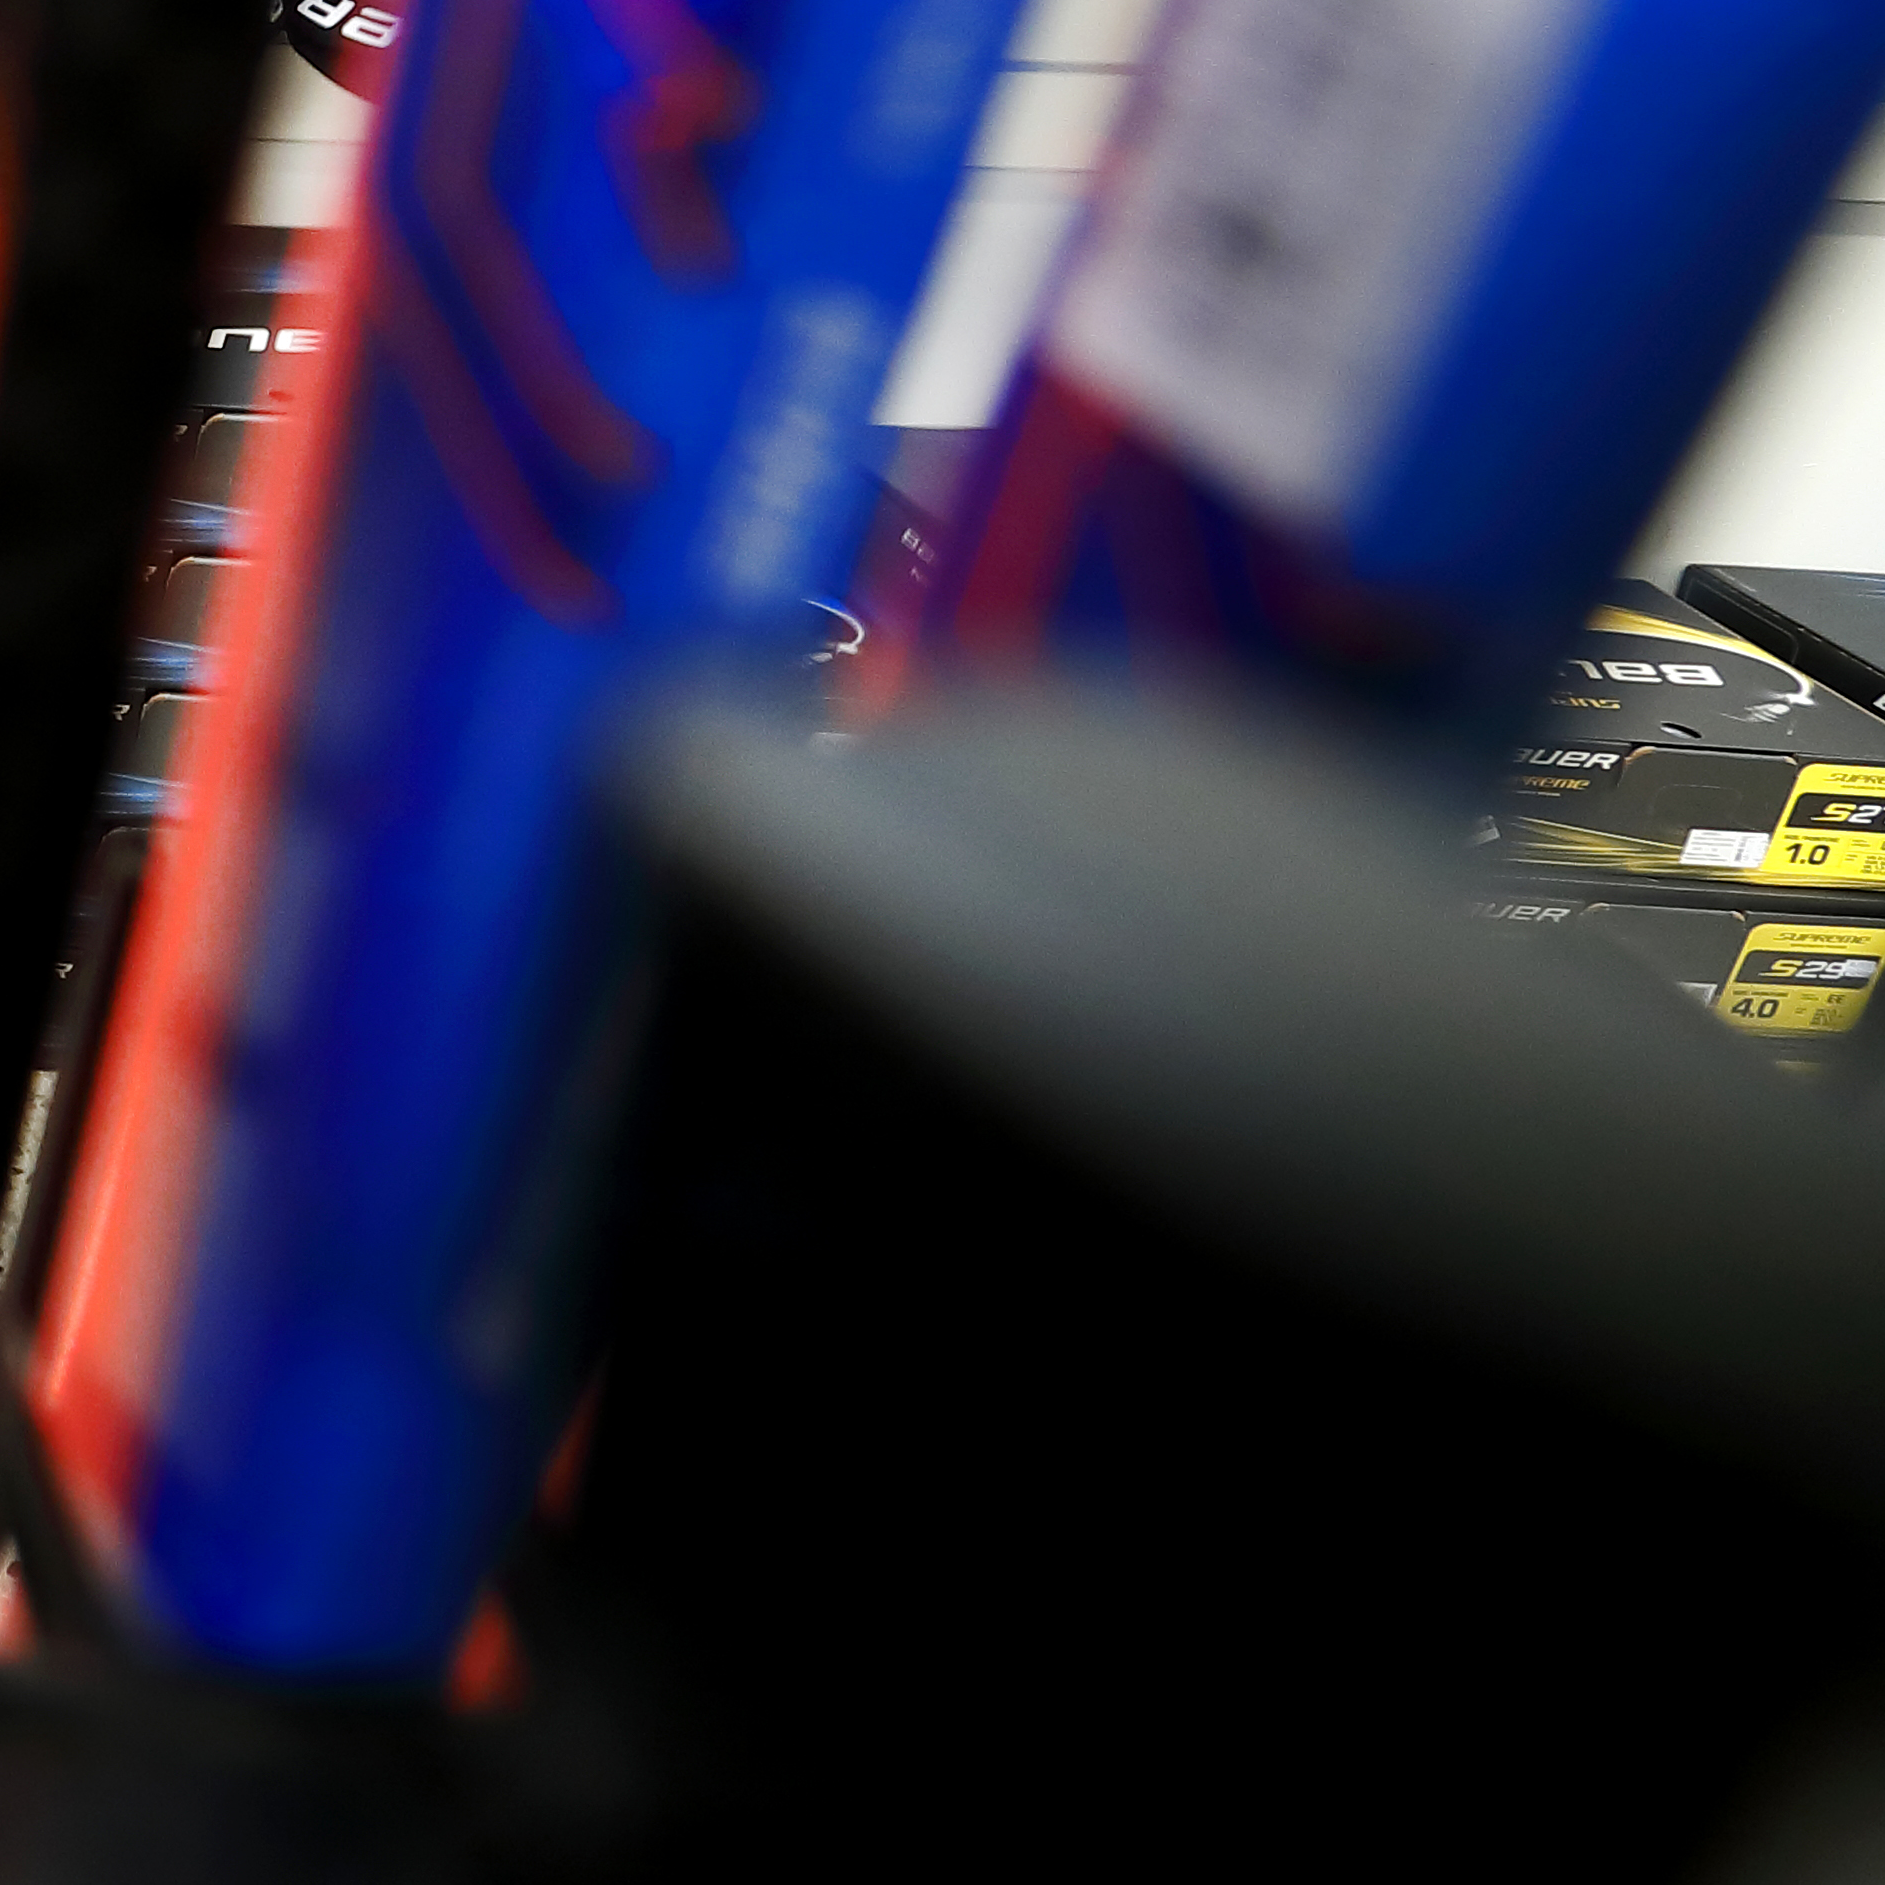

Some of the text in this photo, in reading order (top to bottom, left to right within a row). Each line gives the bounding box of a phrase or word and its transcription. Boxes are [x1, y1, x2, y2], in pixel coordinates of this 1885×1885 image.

[1566, 659, 1725, 687] BAU
[1513, 748, 1621, 770] AUER
[1823, 773, 1885, 785] SUPRE
[1810, 802, 1885, 824] S2
[1786, 843, 1831, 865] 1.0
[1731, 998, 1780, 1019] 4.0
